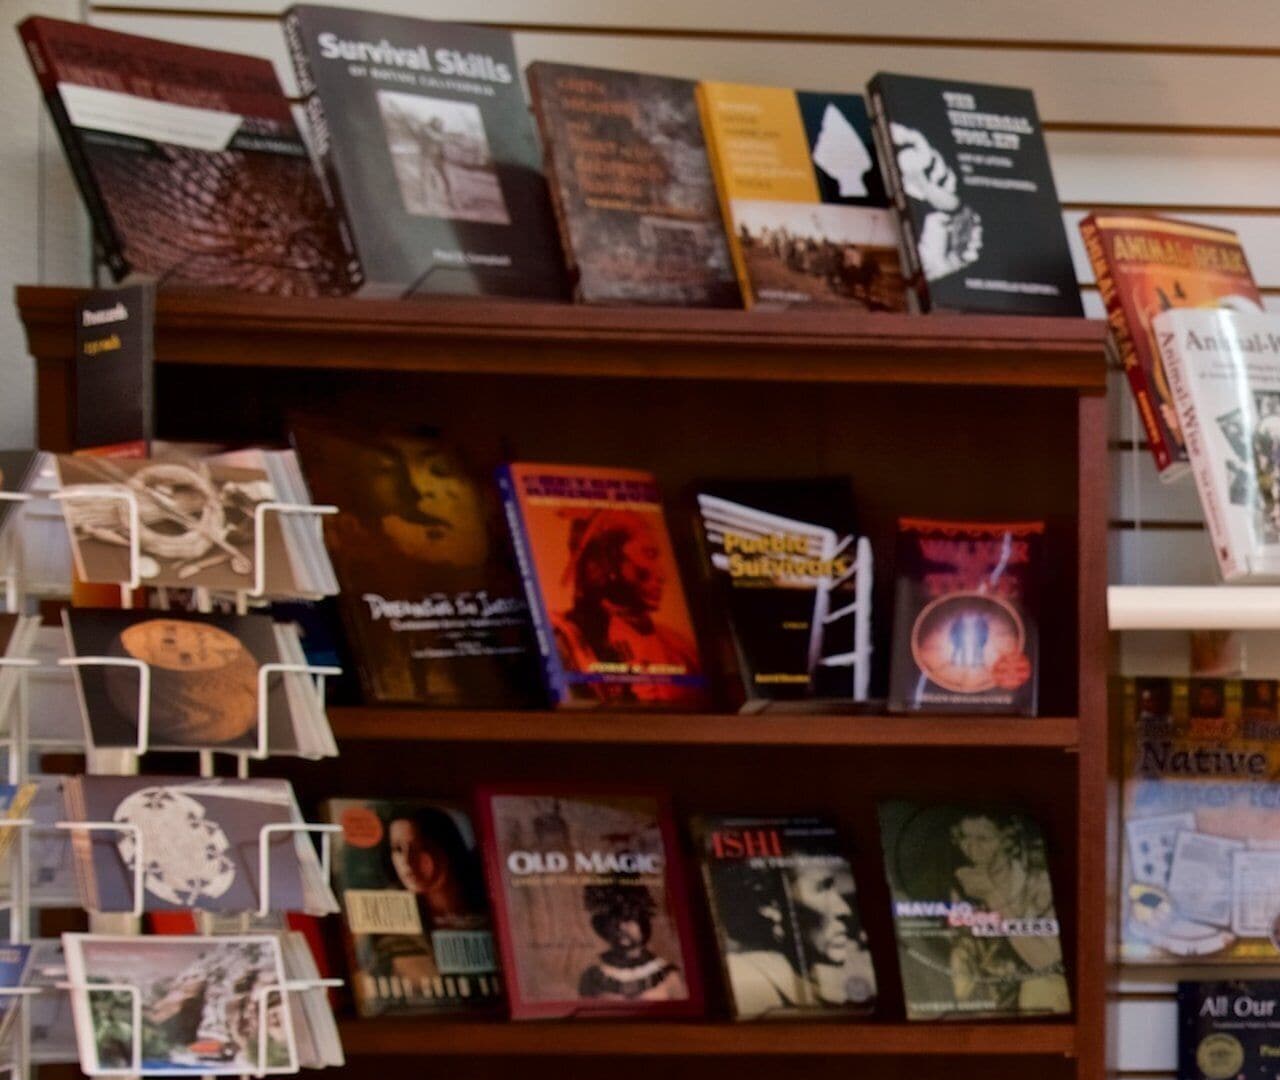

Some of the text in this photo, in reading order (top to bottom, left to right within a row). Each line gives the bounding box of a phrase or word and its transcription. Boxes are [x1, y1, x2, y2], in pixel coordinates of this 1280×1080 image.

[318, 32, 512, 85] Survival Skills
[943, 91, 974, 111] THE
[950, 127, 1020, 150] TOOL KIT
[1111, 234, 1187, 265] ANIMAL
[1158, 331, 1201, 458] Animal-Wise
[723, 532, 811, 554] Pueblo
[728, 552, 850, 578] Survivors
[1139, 741, 1268, 777] Native
[711, 829, 782, 859] ISHI
[507, 849, 663, 876] OLD MAGIC
[895, 901, 974, 918] NAVAJO
[1200, 996, 1229, 1017] All
[1233, 996, 1275, 1018] Our
